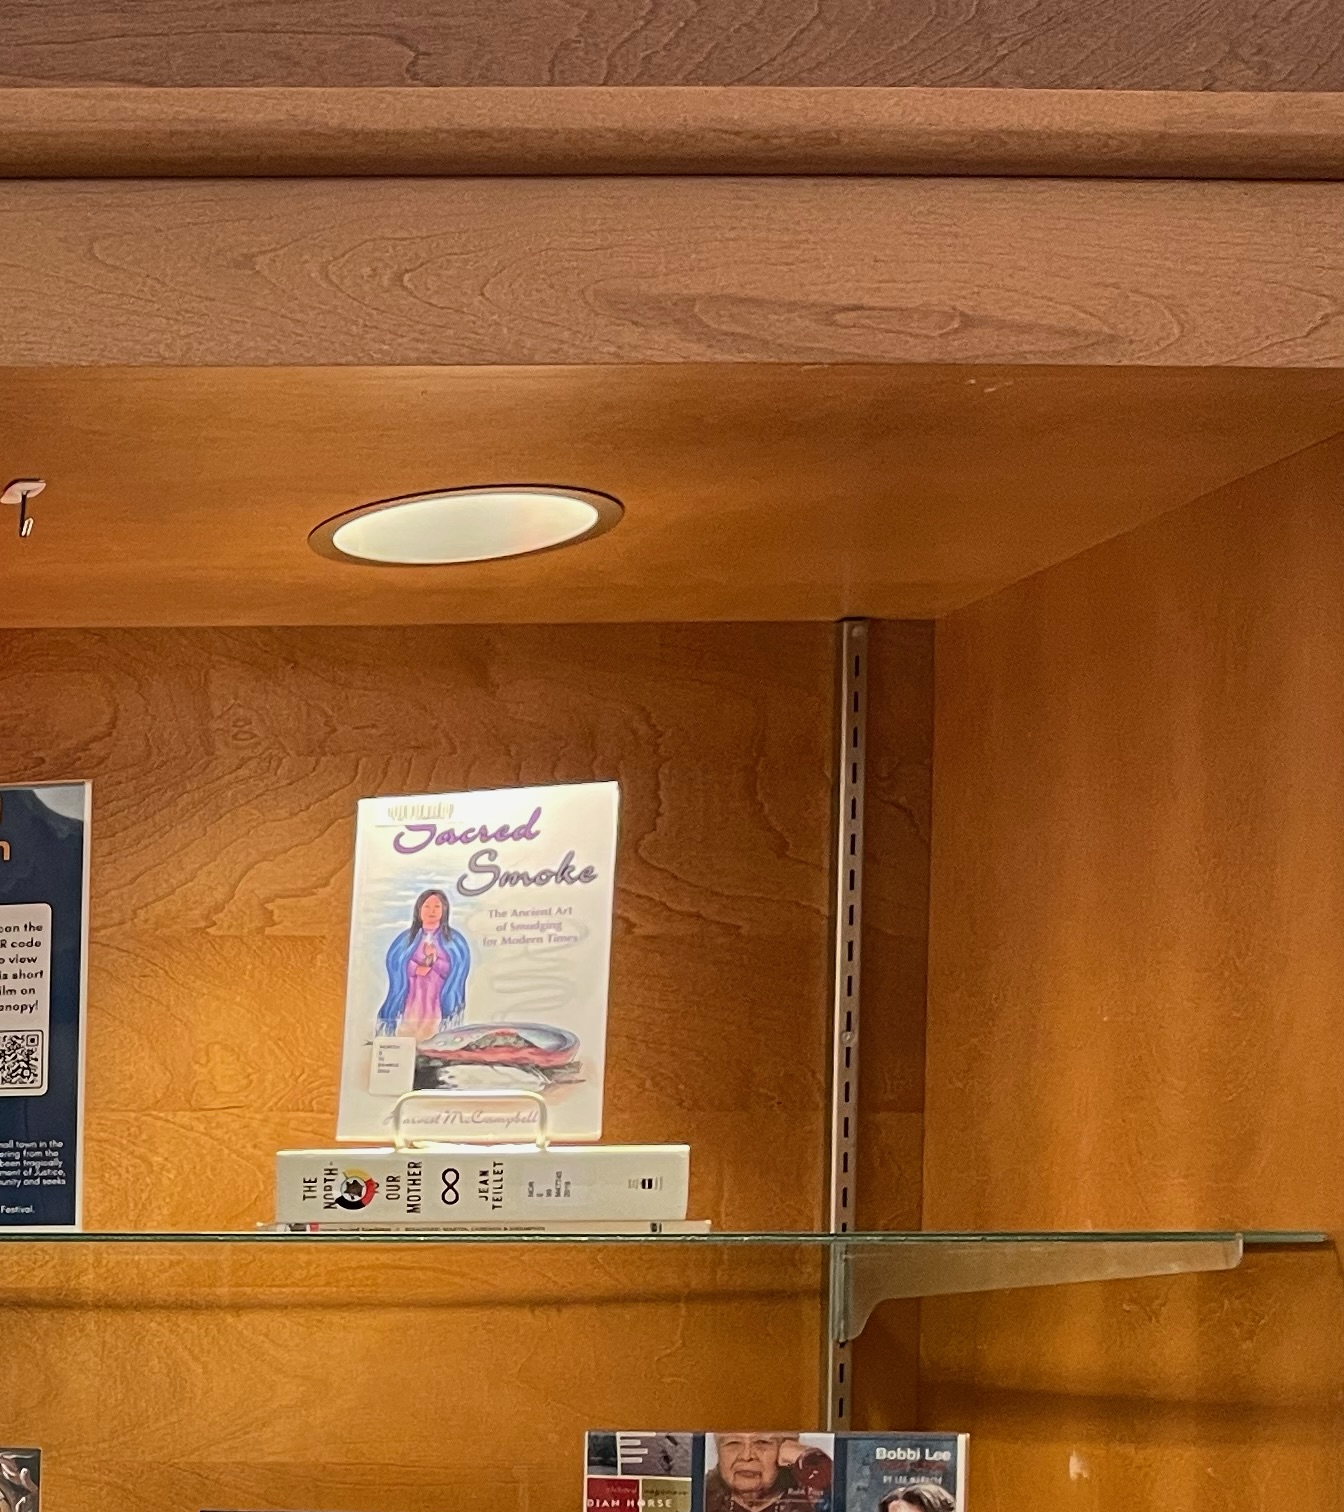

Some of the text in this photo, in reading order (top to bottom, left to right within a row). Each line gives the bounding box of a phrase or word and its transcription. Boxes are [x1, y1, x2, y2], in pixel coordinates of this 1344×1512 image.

[392, 806, 543, 855] Sacred
[456, 850, 599, 898] Smoke
[24, 921, 43, 932] the
[11, 937, 41, 948] code
[9, 954, 37, 963] view
[12, 969, 43, 979] short
[21, 987, 35, 995] on
[302, 1176, 318, 1201] THE
[386, 1175, 401, 1201] OUR
[406, 1161, 422, 1214] MOTHER
[478, 1170, 489, 1202] JEAN
[492, 1161, 504, 1210] TEILLET
[875, 1447, 951, 1461] Bobbi Lee
